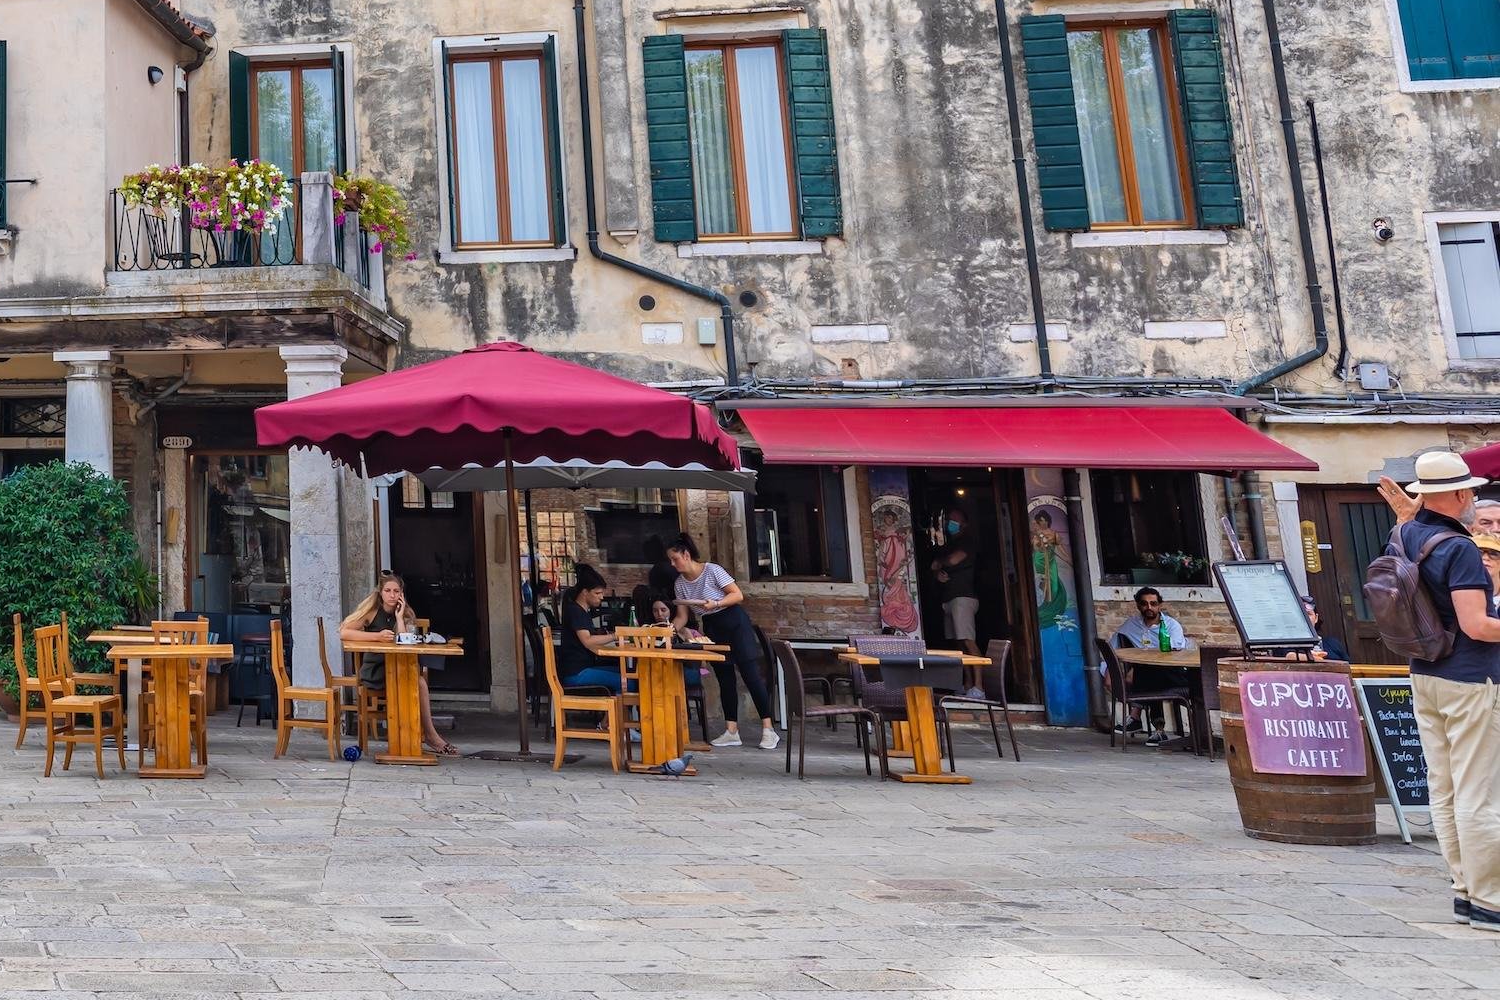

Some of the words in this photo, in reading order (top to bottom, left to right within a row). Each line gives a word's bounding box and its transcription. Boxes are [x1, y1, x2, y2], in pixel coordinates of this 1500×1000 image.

[164, 437, 190, 447] 2891
[1247, 682, 1352, 709] UPUPA
[1263, 718, 1350, 739] RISTORANTE
